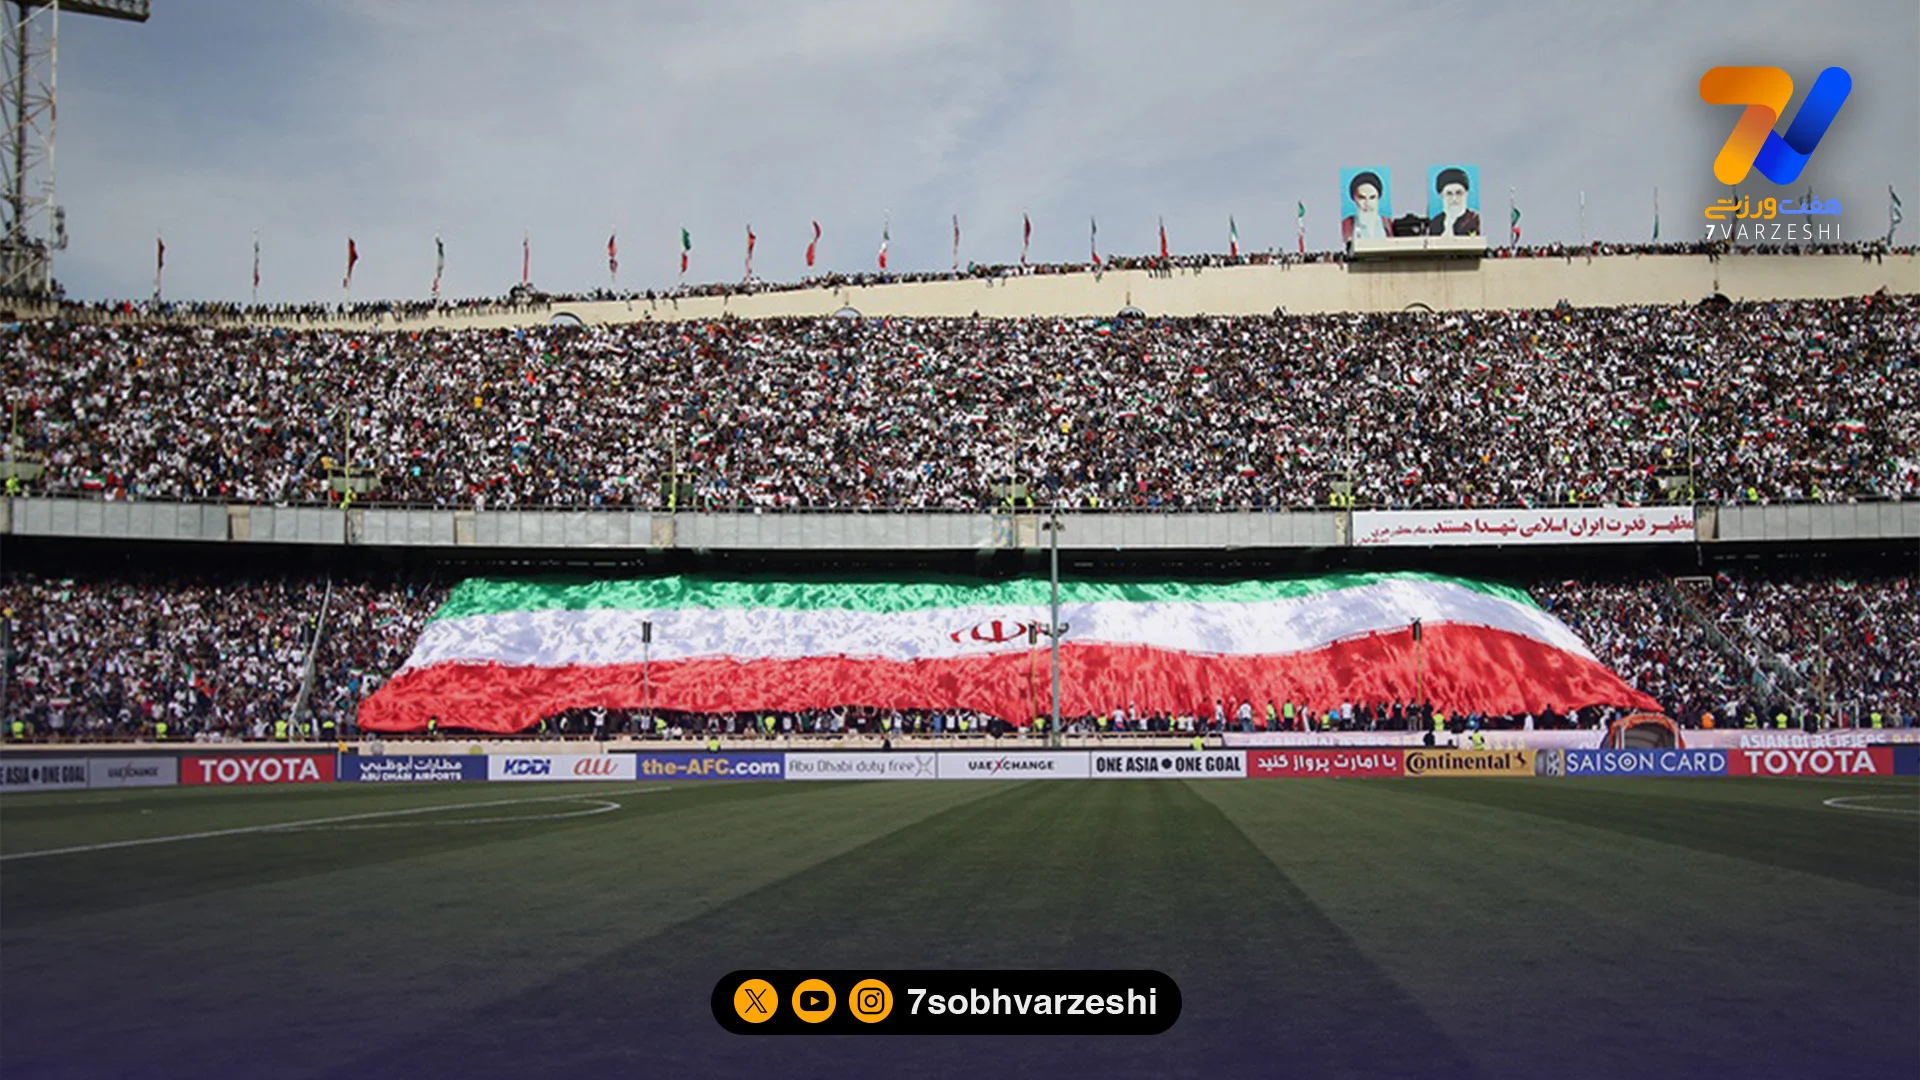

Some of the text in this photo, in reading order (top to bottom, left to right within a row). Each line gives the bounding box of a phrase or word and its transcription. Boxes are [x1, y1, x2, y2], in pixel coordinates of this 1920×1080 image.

[1520, 517, 1568, 537] اسلامی
[1570, 516, 1604, 537] ایران
[1607, 514, 1646, 537] قدرت
[198, 758, 320, 783] TOYOTA
[573, 758, 619, 775] au
[642, 758, 781, 776] the-AFC.com
[789, 760, 915, 774] Abu Dhabi duty free
[1096, 756, 1241, 772] ONE ASIA ONE GOAL
[1258, 754, 1397, 773] با امارت پرواز کنید
[1405, 752, 1511, 775] Continental
[1566, 753, 1725, 772] SAISON CARD
[1745, 750, 1876, 773] TOYOTA
[5, 766, 30, 785] ASIA
[41, 766, 60, 783] ONE
[62, 765, 85, 783] GOAL
[361, 772, 462, 781] ABU DHABI AIRPORTS
